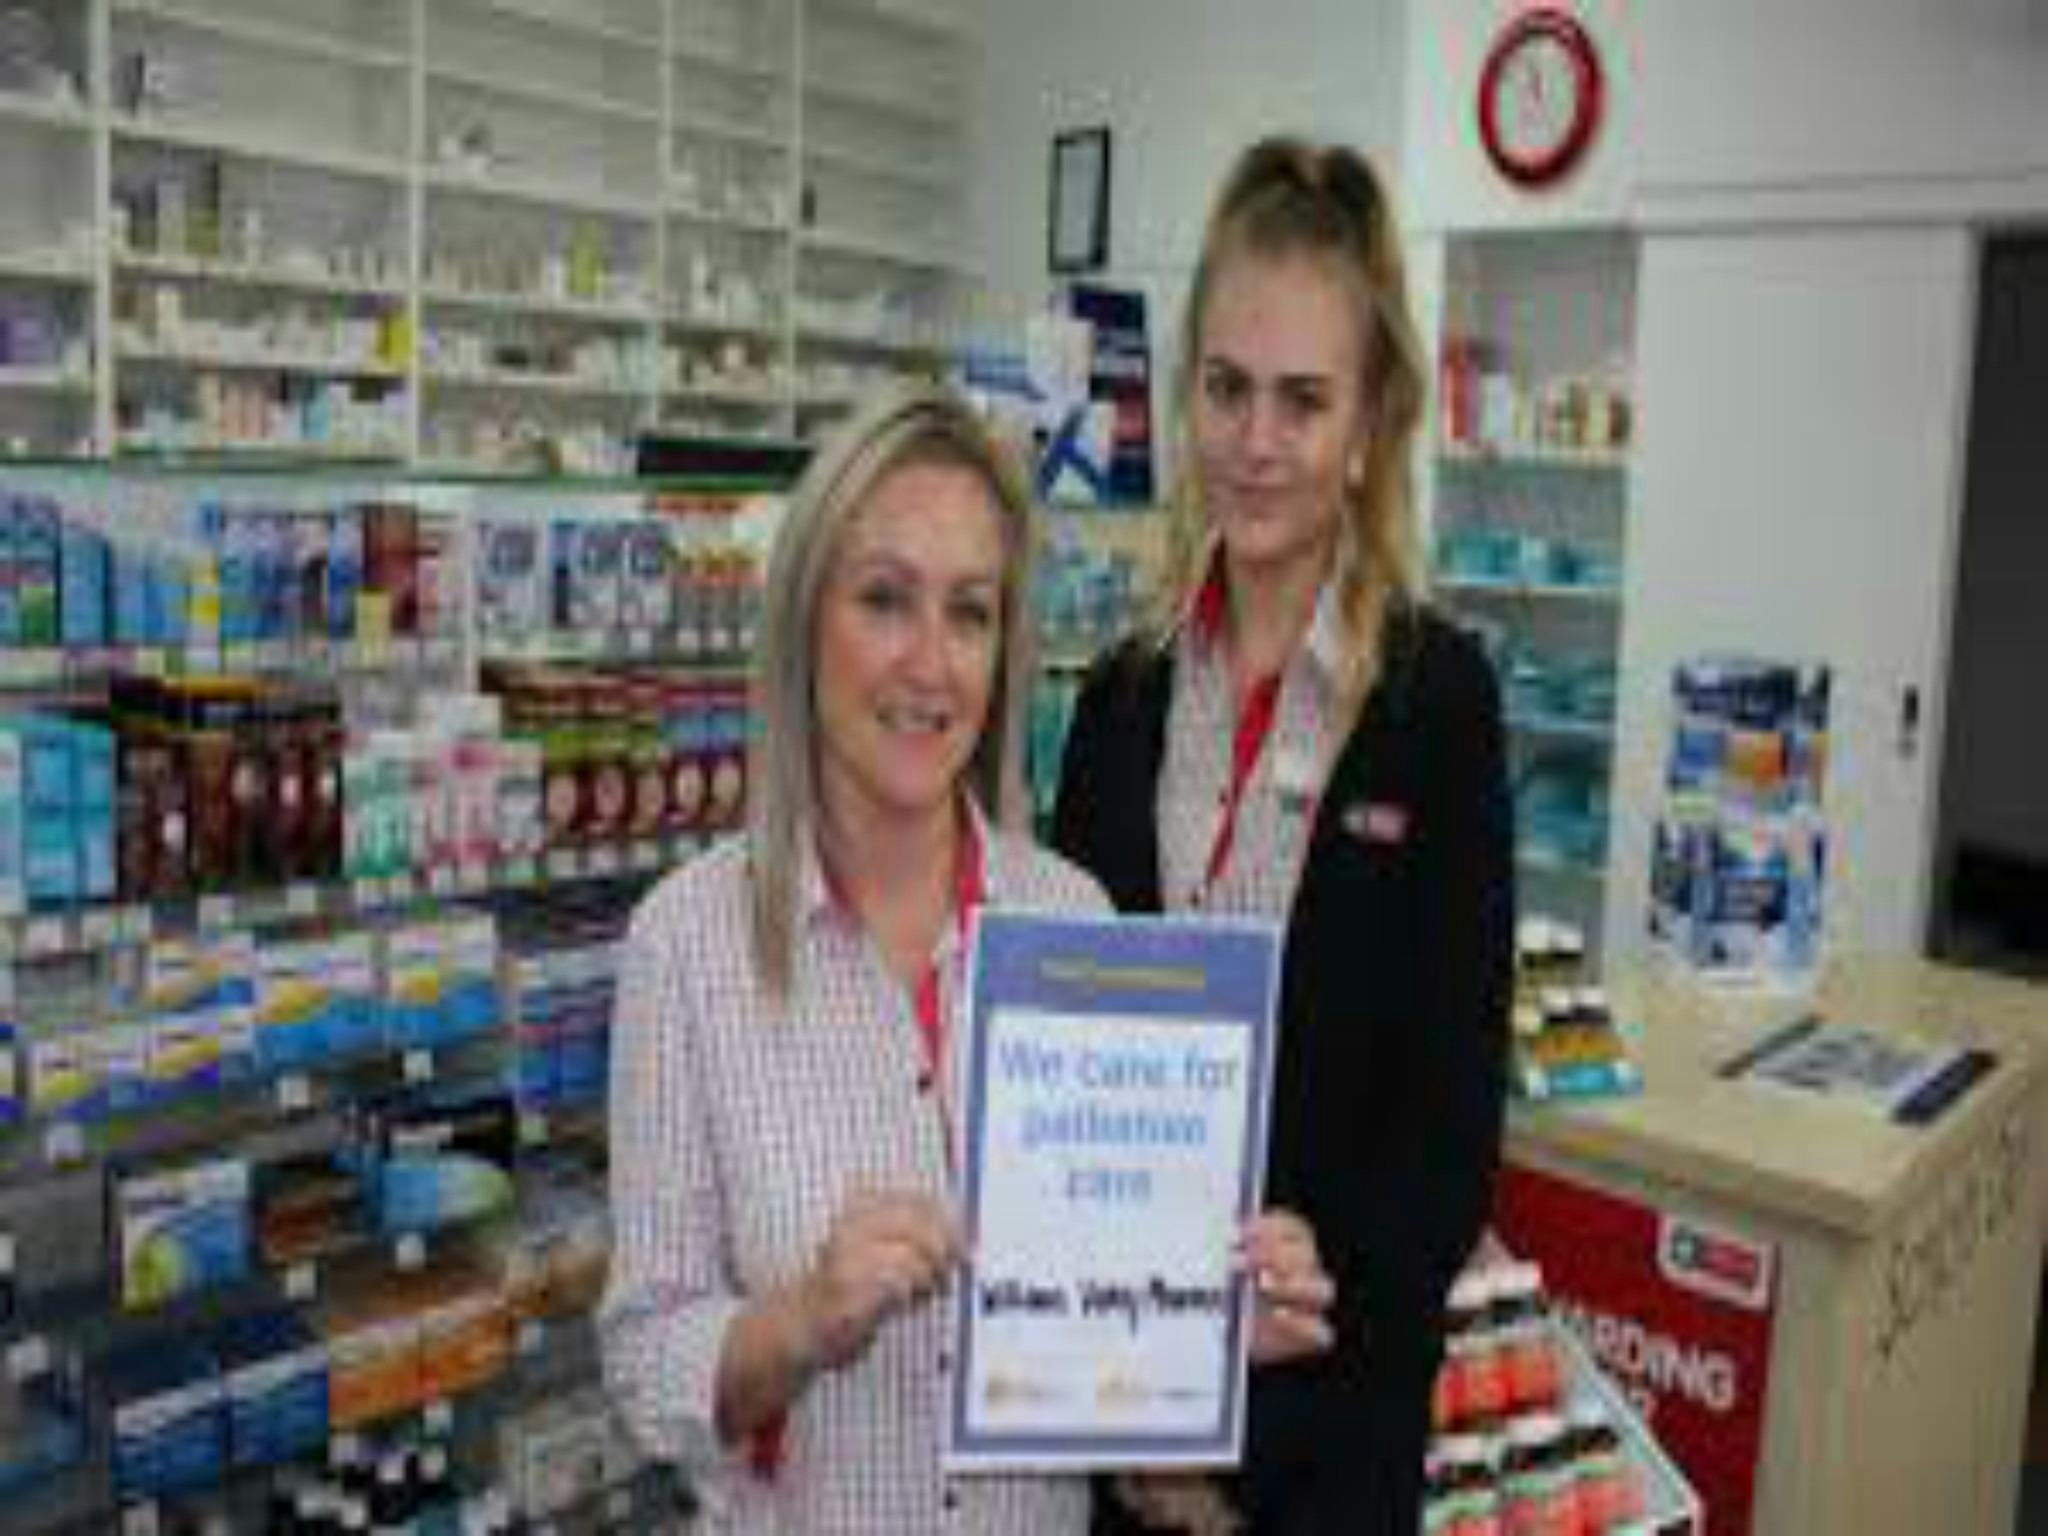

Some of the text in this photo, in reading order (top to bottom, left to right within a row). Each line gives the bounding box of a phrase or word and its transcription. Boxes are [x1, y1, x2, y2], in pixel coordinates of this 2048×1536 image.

[1000, 1041, 1239, 1091] We care for
[1556, 1304, 1736, 1411] ARDING
